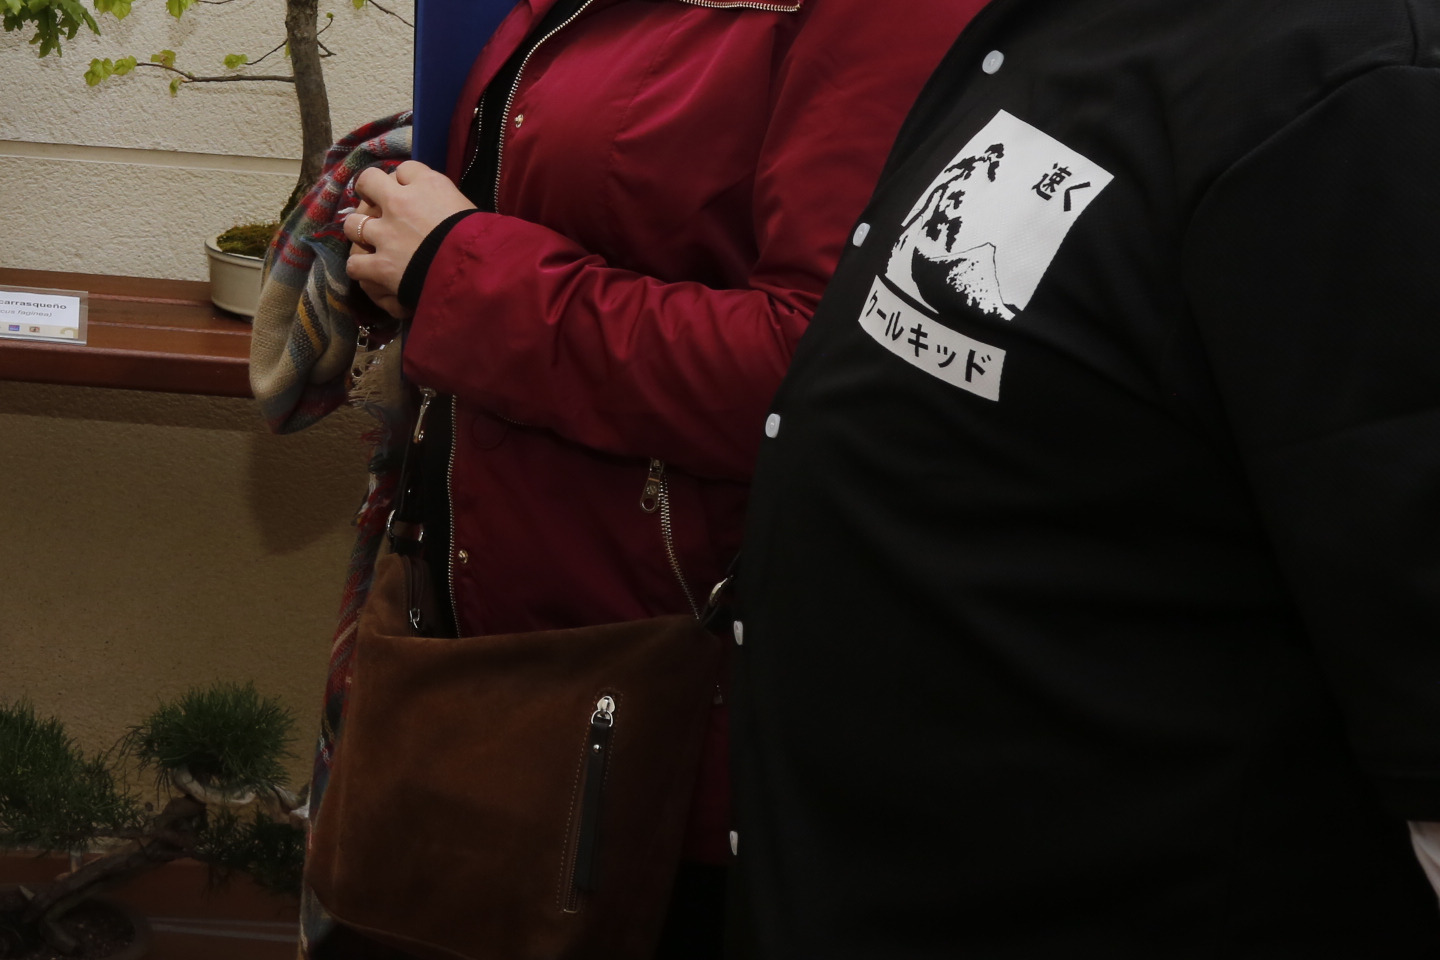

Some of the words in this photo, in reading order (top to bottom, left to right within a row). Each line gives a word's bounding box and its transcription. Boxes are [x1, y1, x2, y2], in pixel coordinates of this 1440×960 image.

[1031, 162, 1091, 212] 速く
[18, 309, 52, 317] faginea)
[866, 290, 991, 383] クールキッド
